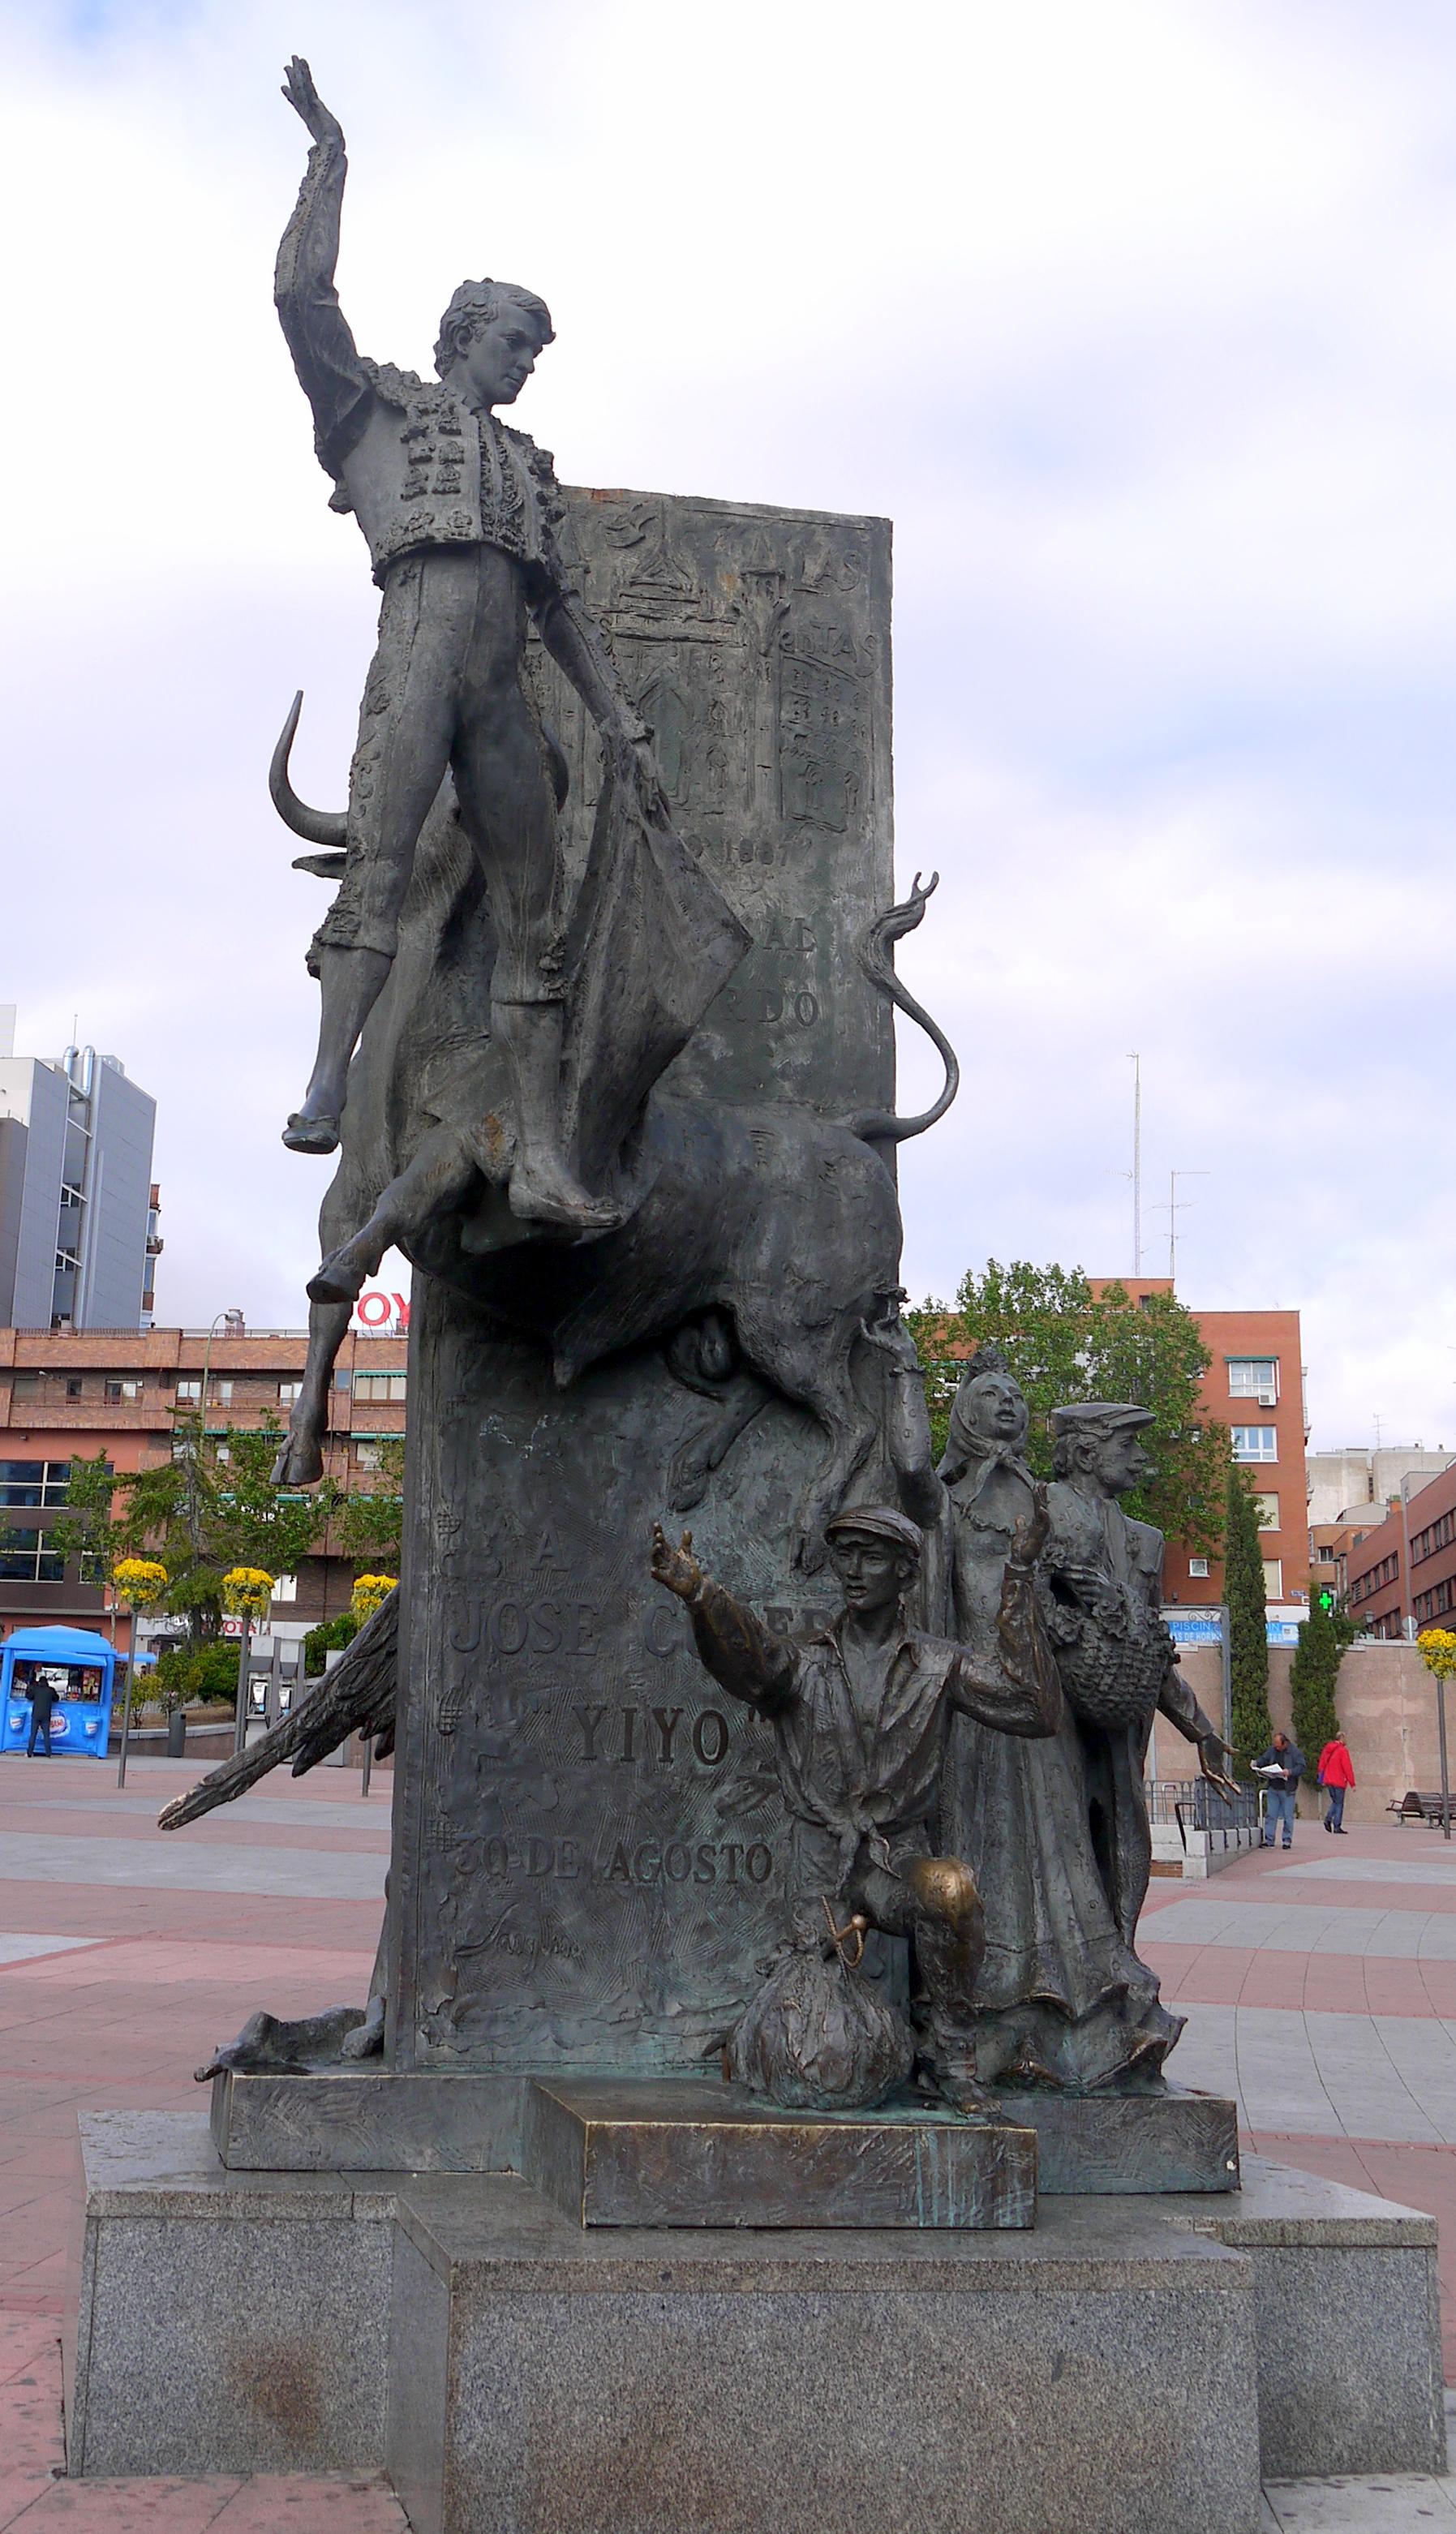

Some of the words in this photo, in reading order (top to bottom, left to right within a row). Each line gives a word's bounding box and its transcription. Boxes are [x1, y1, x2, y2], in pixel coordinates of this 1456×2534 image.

[531, 1525, 569, 1571] A
[450, 1598, 599, 1655] JOSE
[526, 1836, 580, 1879] DE
[603, 1841, 773, 1884] AGOSTO
